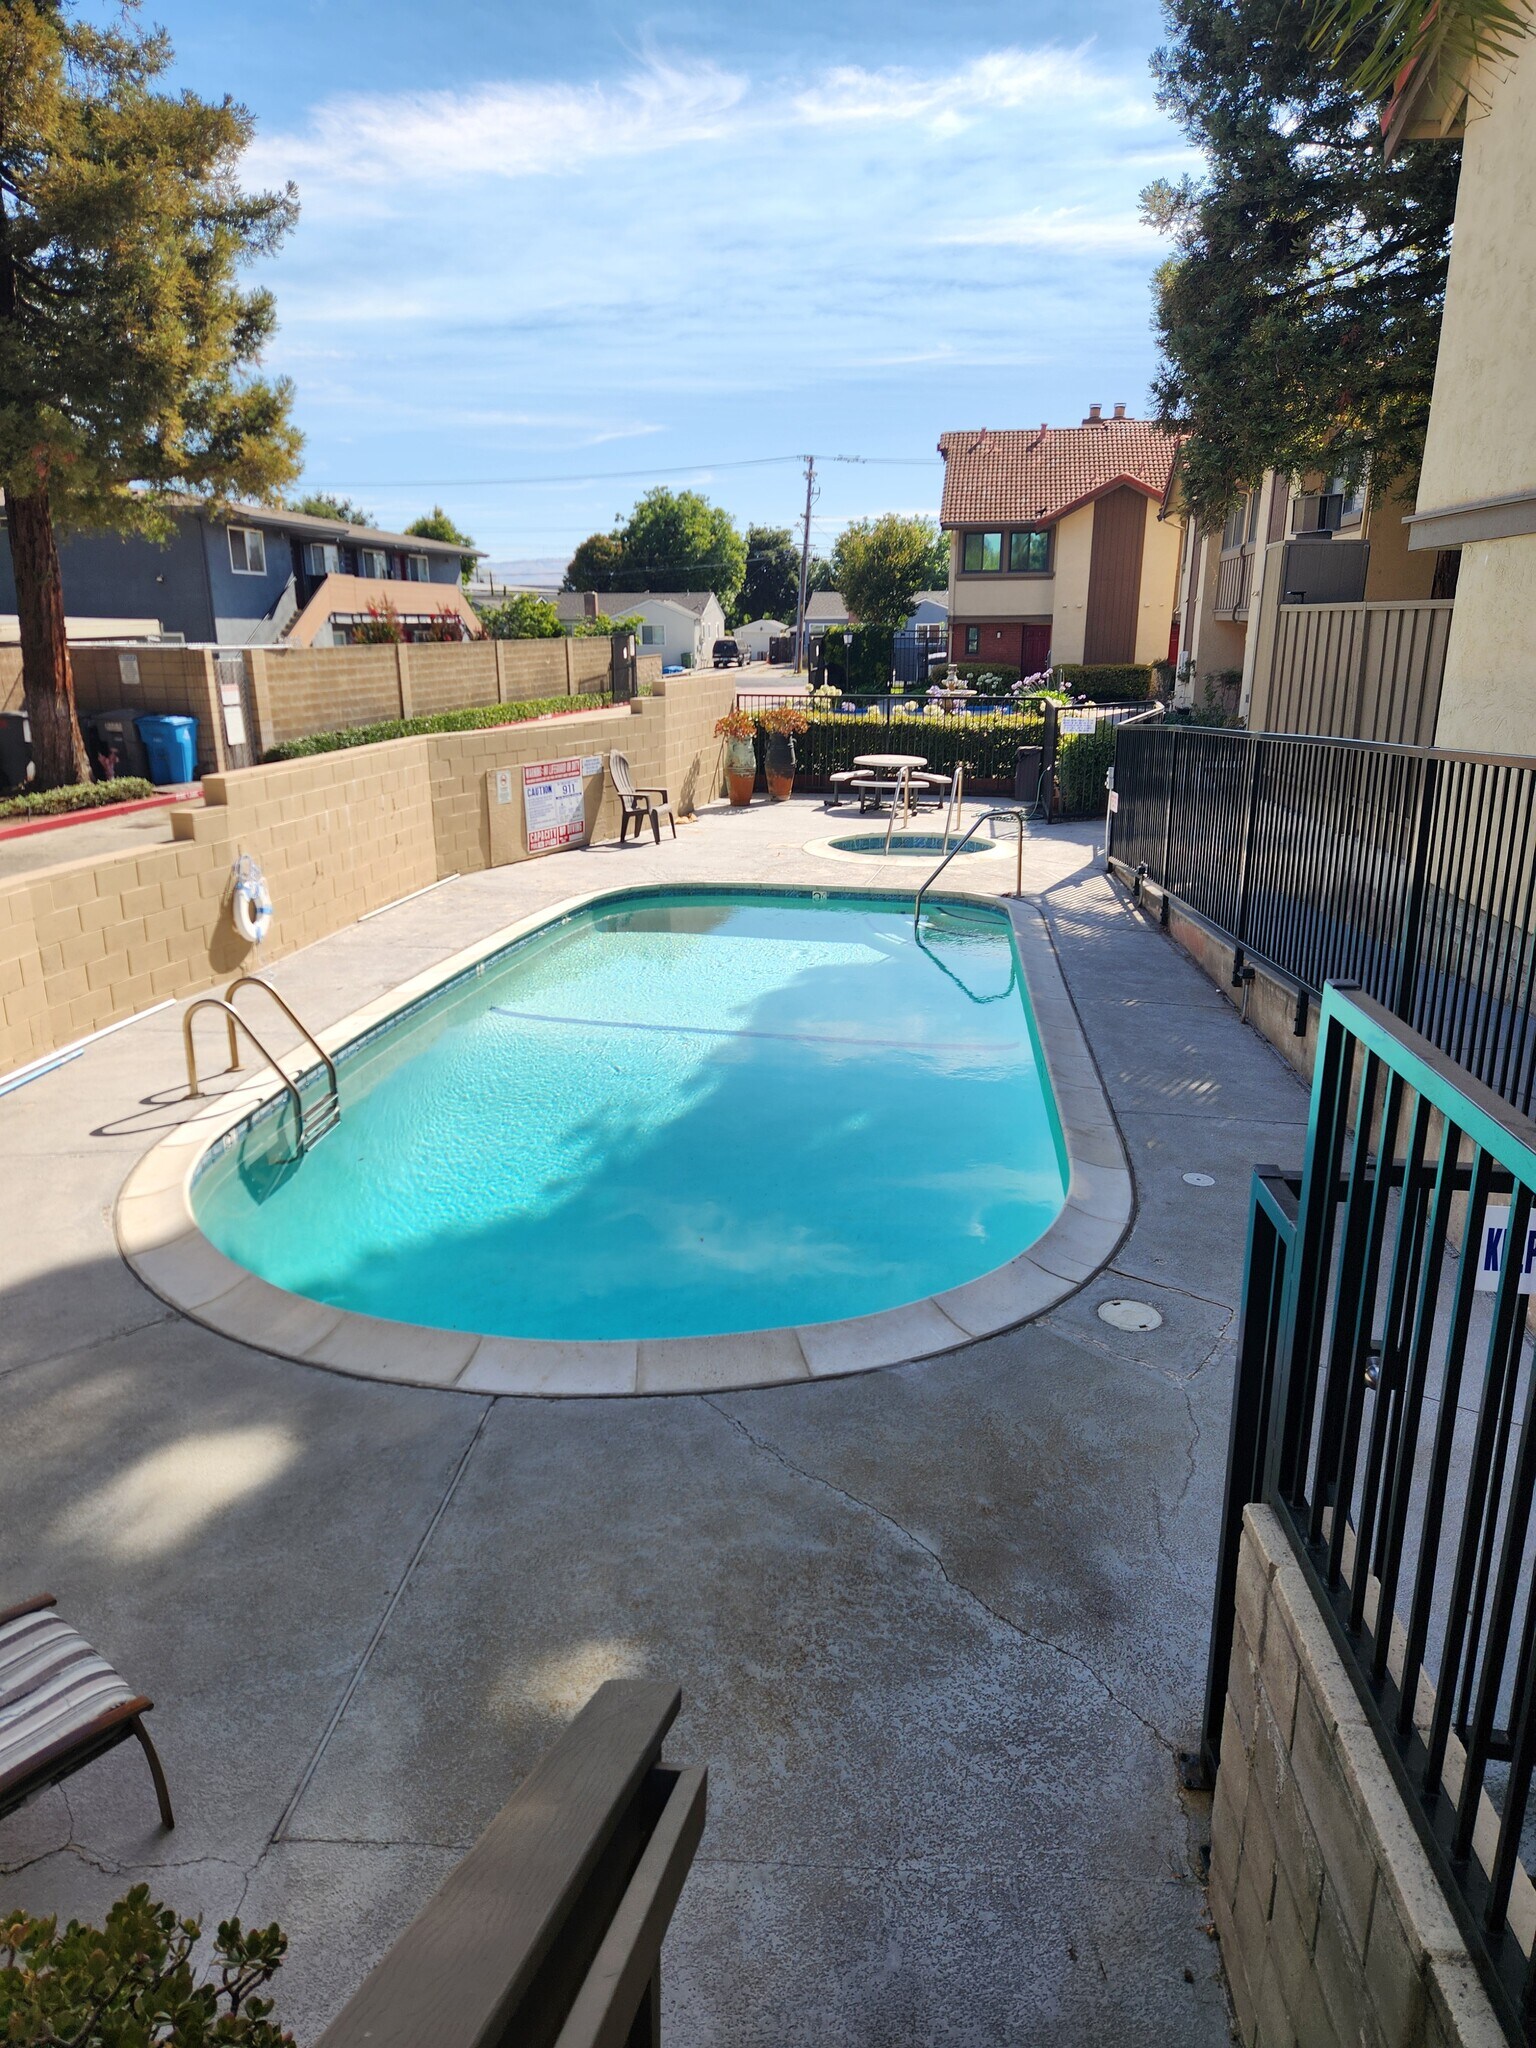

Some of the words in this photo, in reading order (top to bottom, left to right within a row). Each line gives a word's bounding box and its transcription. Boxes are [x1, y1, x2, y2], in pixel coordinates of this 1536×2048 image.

[527, 785, 552, 797] CAUTION
[563, 784, 575, 795] 911
[530, 828, 557, 843] CAPACITY
[1484, 1227, 1536, 1273] KP
